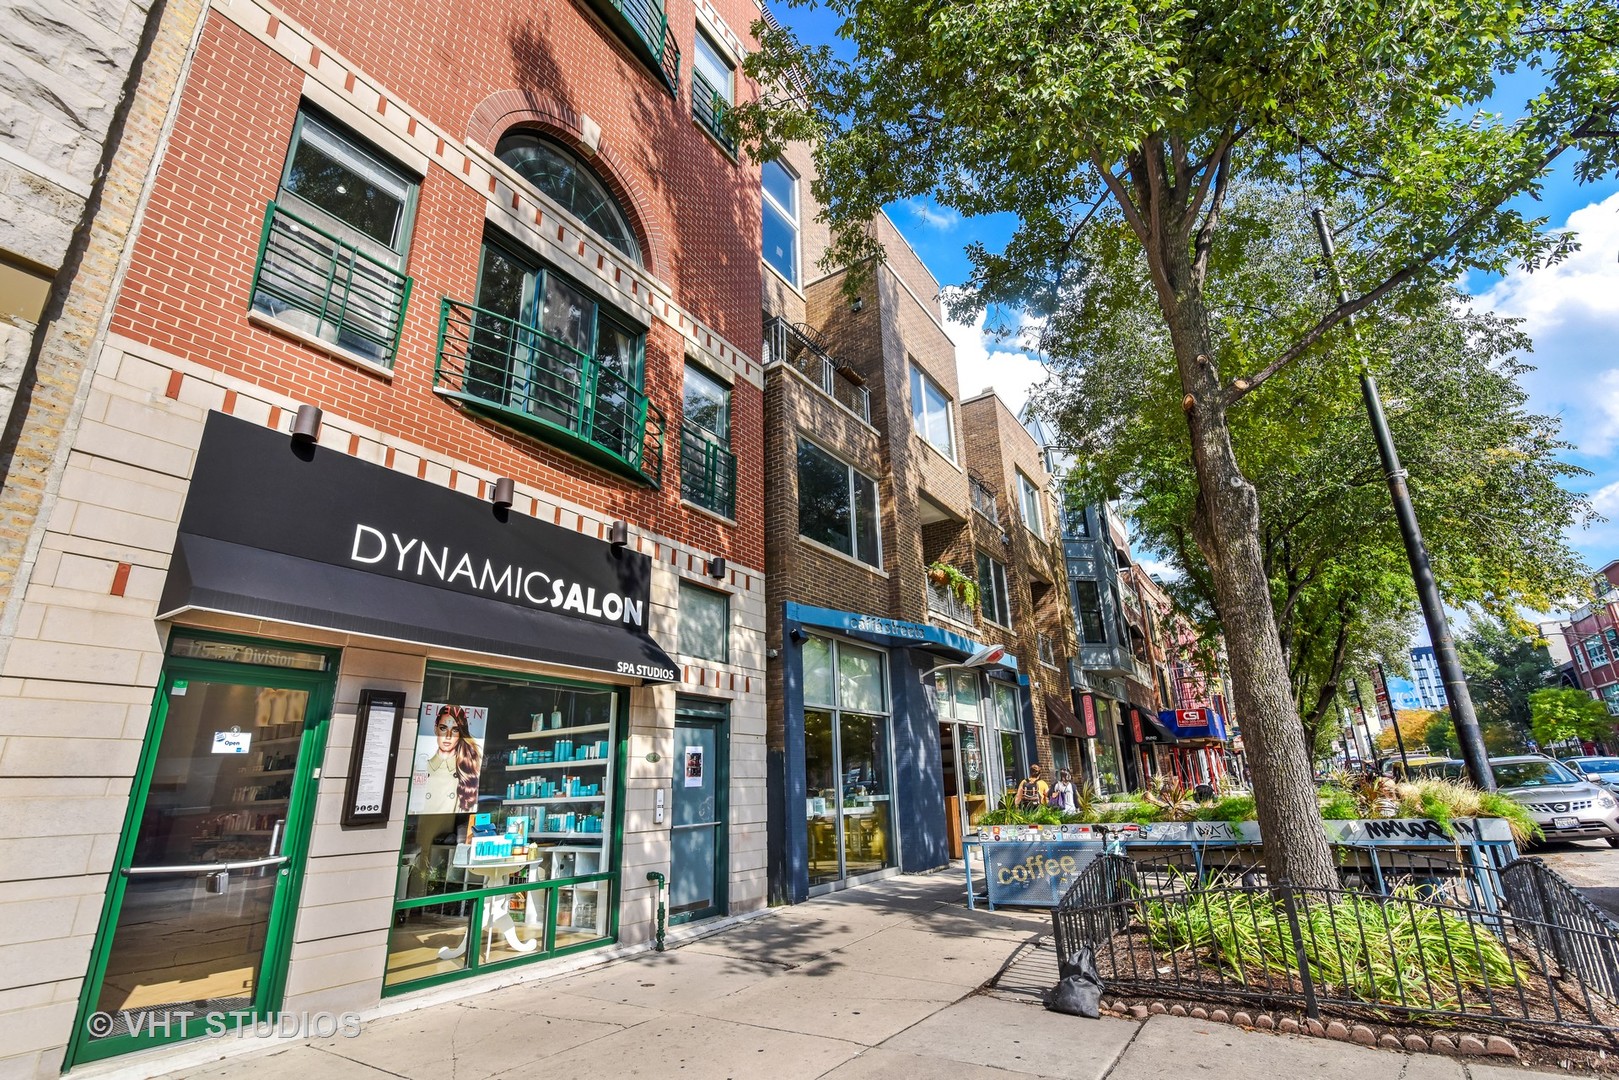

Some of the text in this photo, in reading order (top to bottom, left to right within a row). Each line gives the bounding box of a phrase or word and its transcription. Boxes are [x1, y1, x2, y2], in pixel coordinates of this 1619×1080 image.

[885, 621, 925, 639] streets
[244, 647, 295, 667] Division
[617, 661, 674, 680] SPA STUDIOS
[1183, 711, 1200, 720] CSI
[998, 854, 1077, 885] coffee
